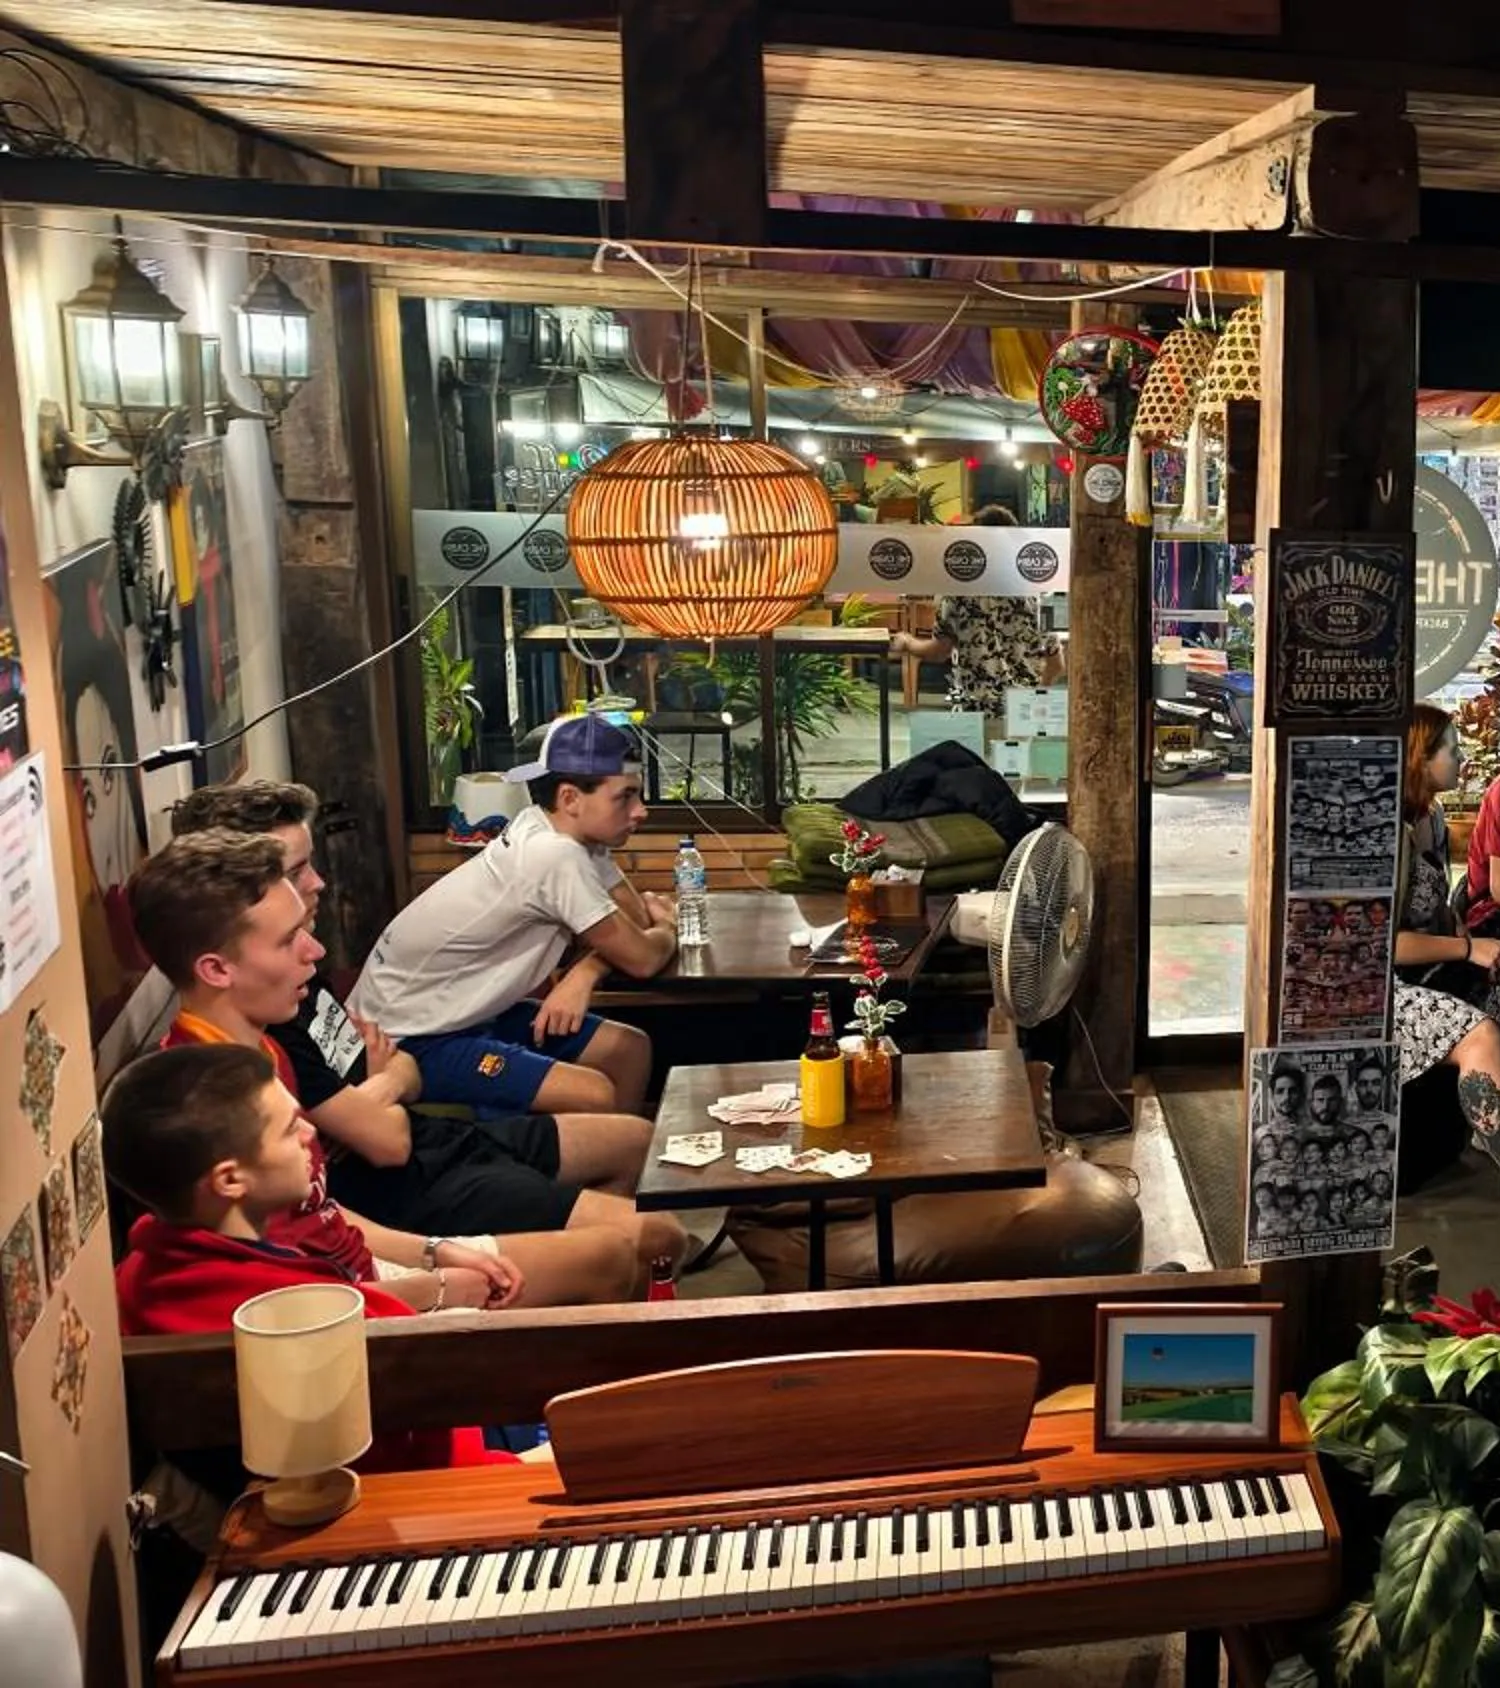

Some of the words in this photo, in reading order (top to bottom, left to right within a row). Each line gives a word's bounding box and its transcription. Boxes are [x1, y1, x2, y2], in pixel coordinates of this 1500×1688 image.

[1283, 563, 1330, 601] JACK
[1296, 648, 1388, 670] Tennessee
[1291, 683, 1390, 701] WHISKEY
